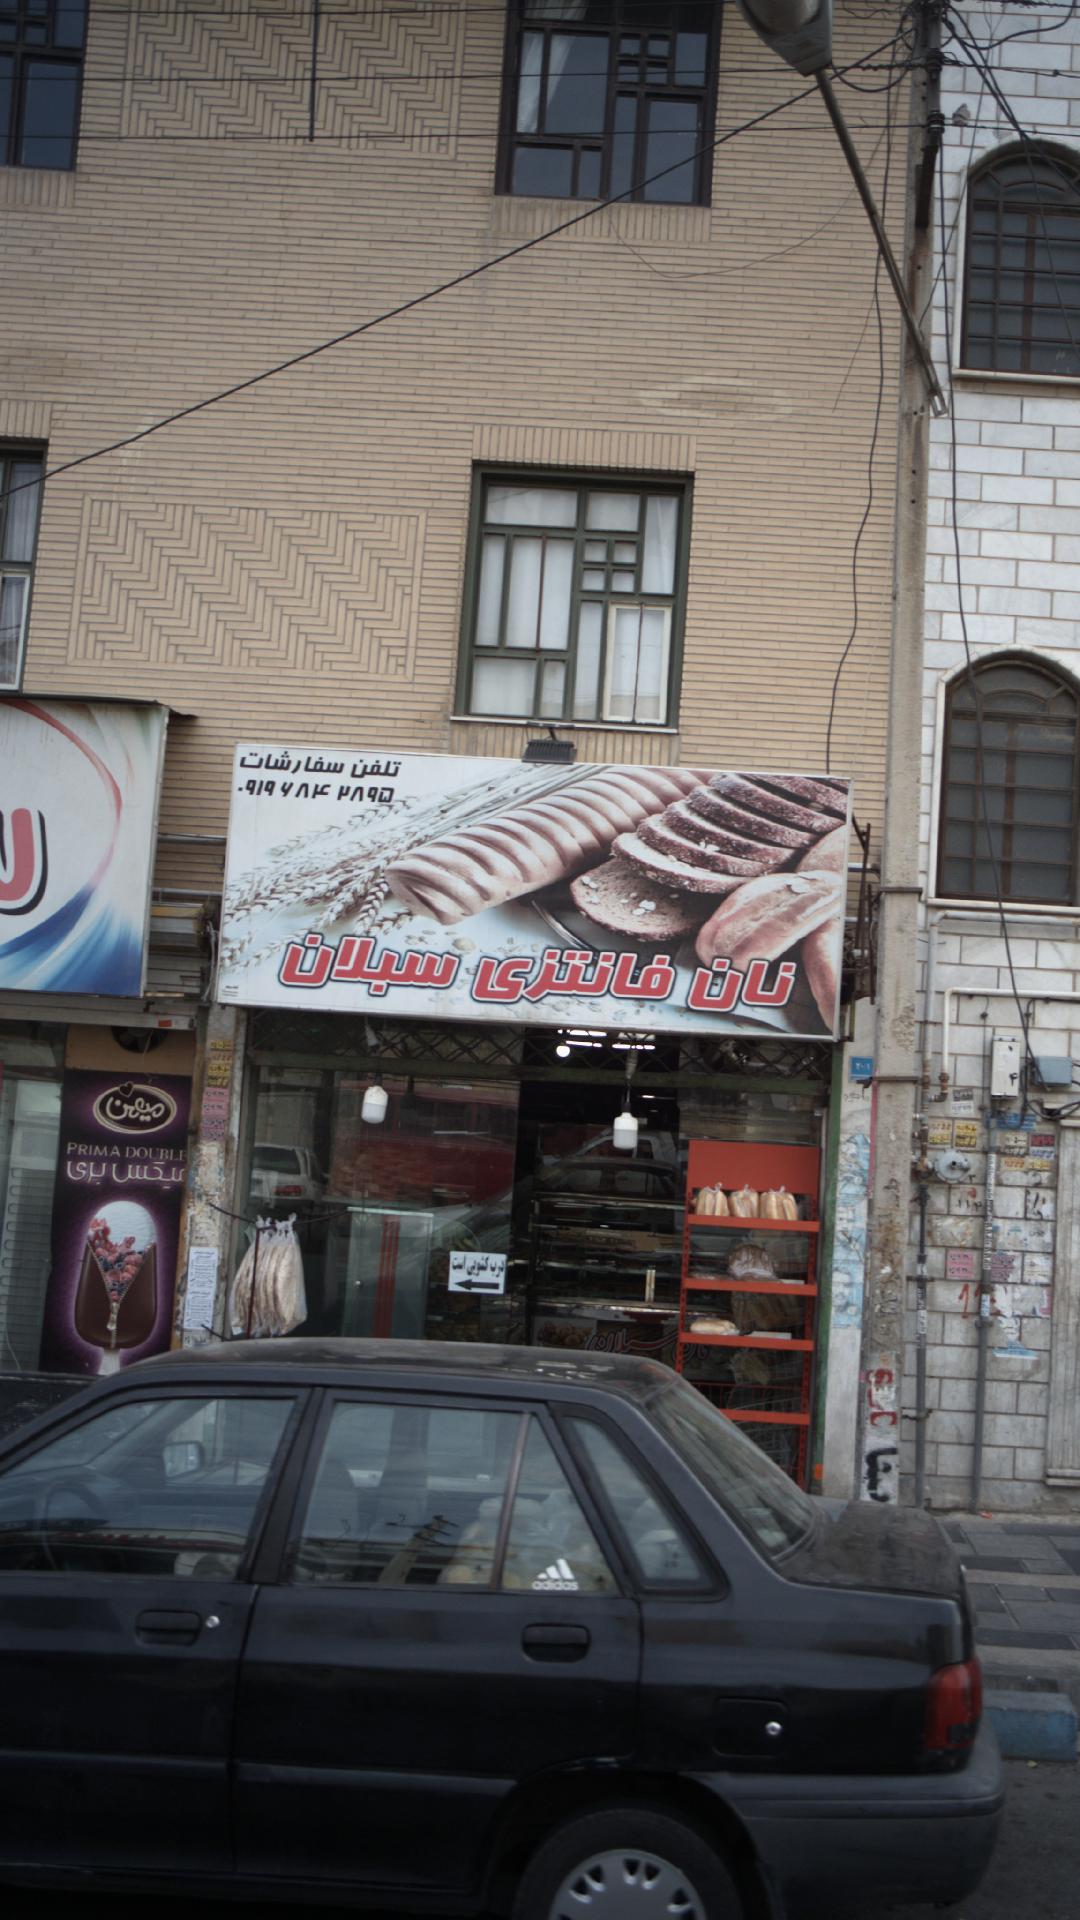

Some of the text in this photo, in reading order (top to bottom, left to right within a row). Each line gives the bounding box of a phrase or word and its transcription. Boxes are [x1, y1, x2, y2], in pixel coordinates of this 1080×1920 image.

[239, 750, 402, 779] تلفن سفارشات
[278, 933, 798, 1013] نان فانتزی سبلان
[105, 1096, 166, 1122] میهن
[66, 1142, 121, 1158] PRIMA
[531, 1579, 580, 1592] adidas
